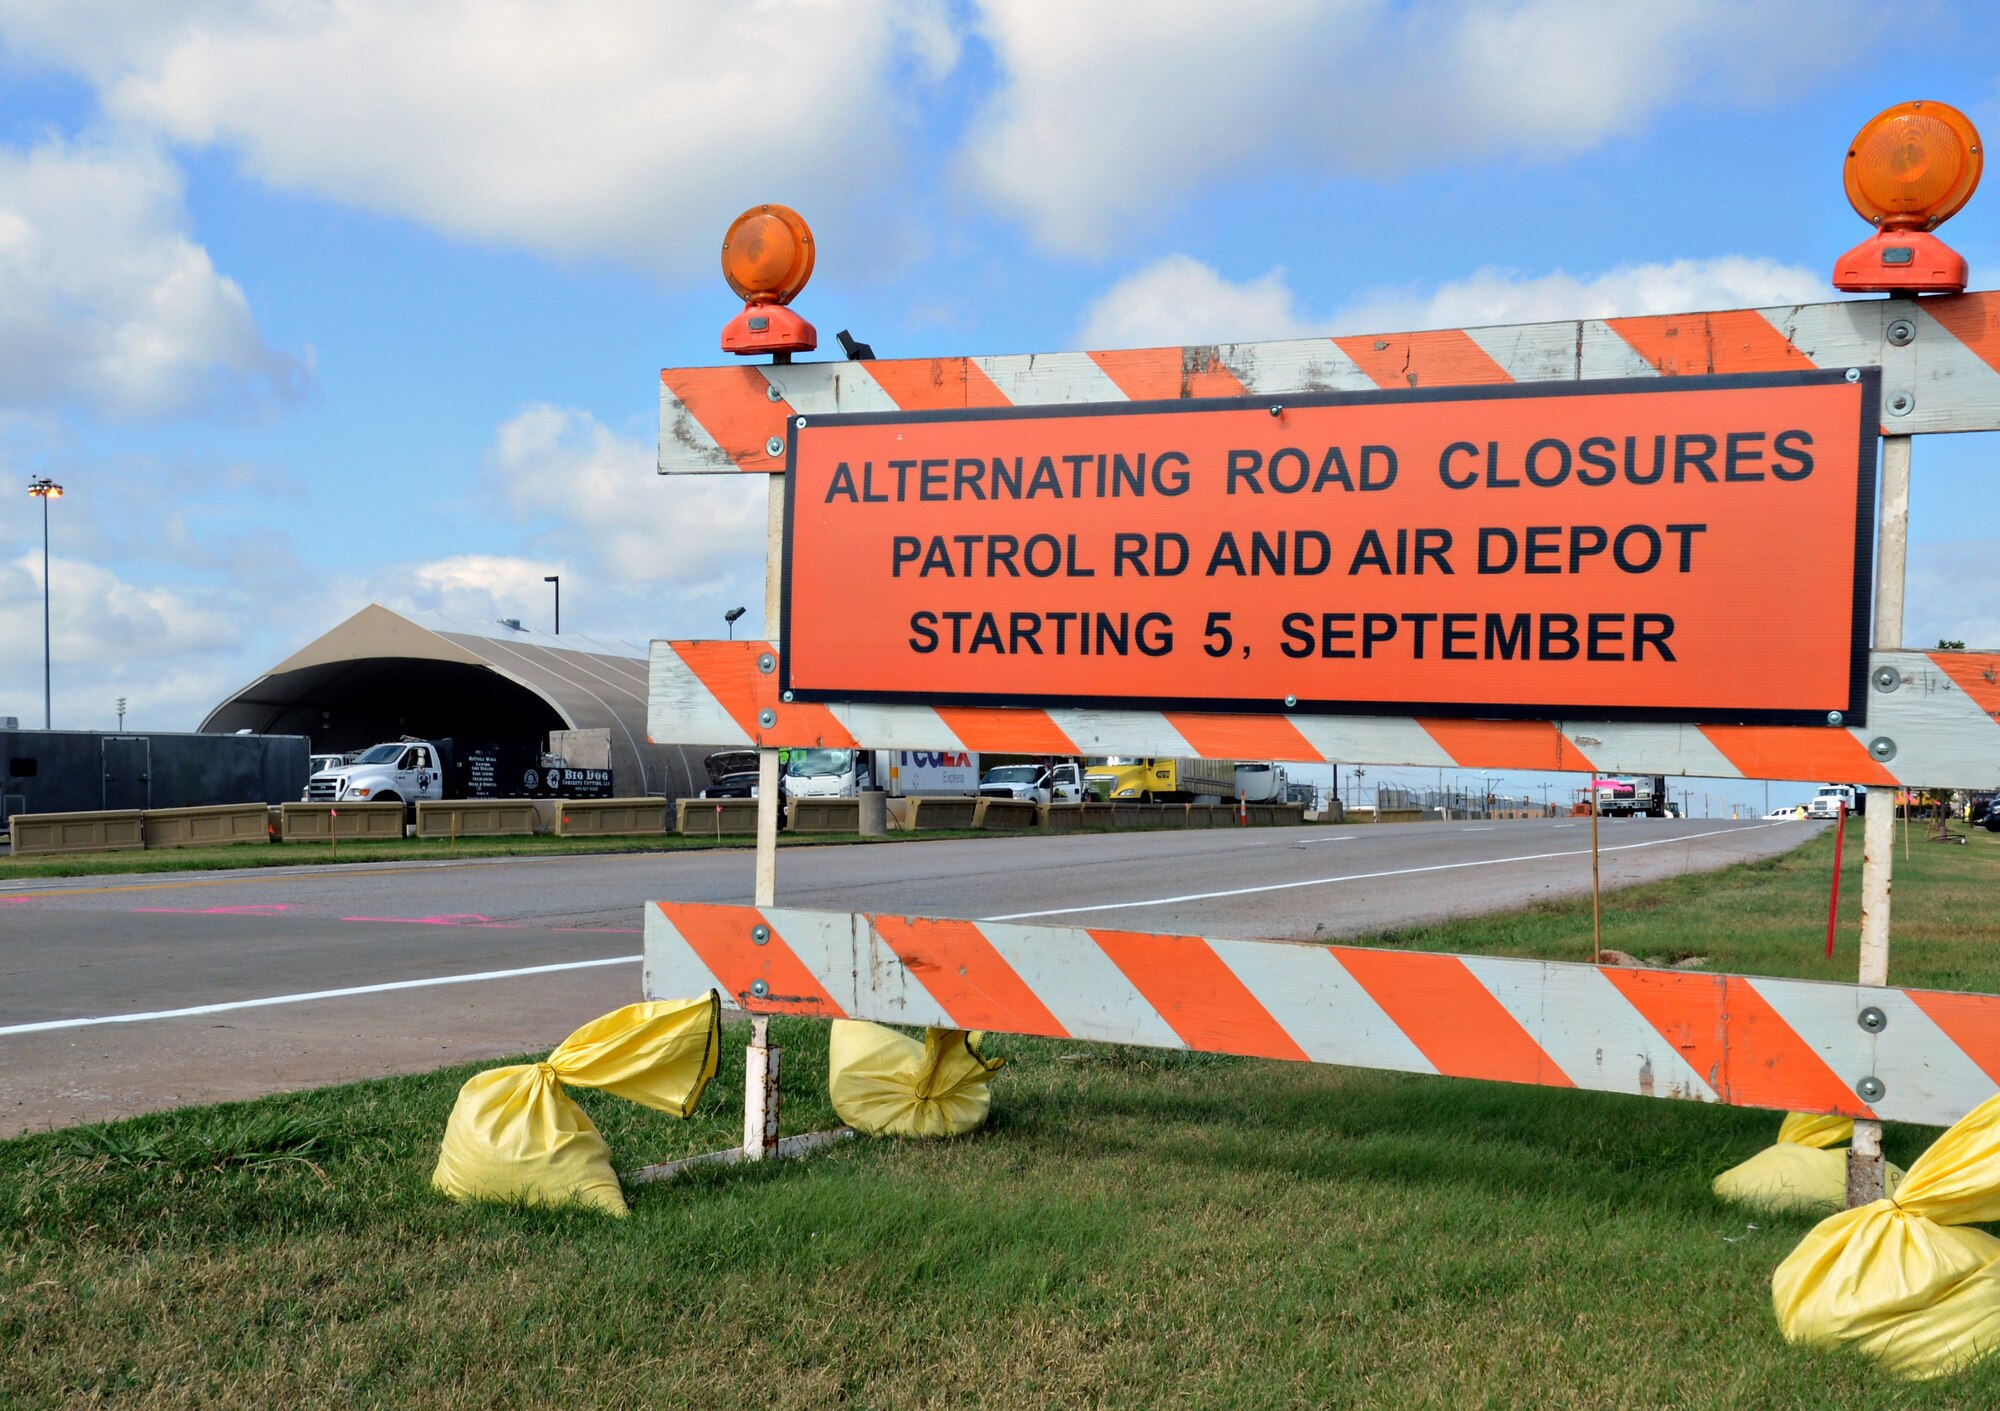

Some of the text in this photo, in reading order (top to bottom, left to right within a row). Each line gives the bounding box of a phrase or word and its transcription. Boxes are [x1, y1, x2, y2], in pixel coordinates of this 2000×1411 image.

[826, 429, 1815, 503] ALTERNATING ROAD CLOSURES
[892, 523, 1707, 578] PATROL RD AND AIR DEPOT
[908, 610, 1678, 664] STARTING 5, SEPTEMBER
